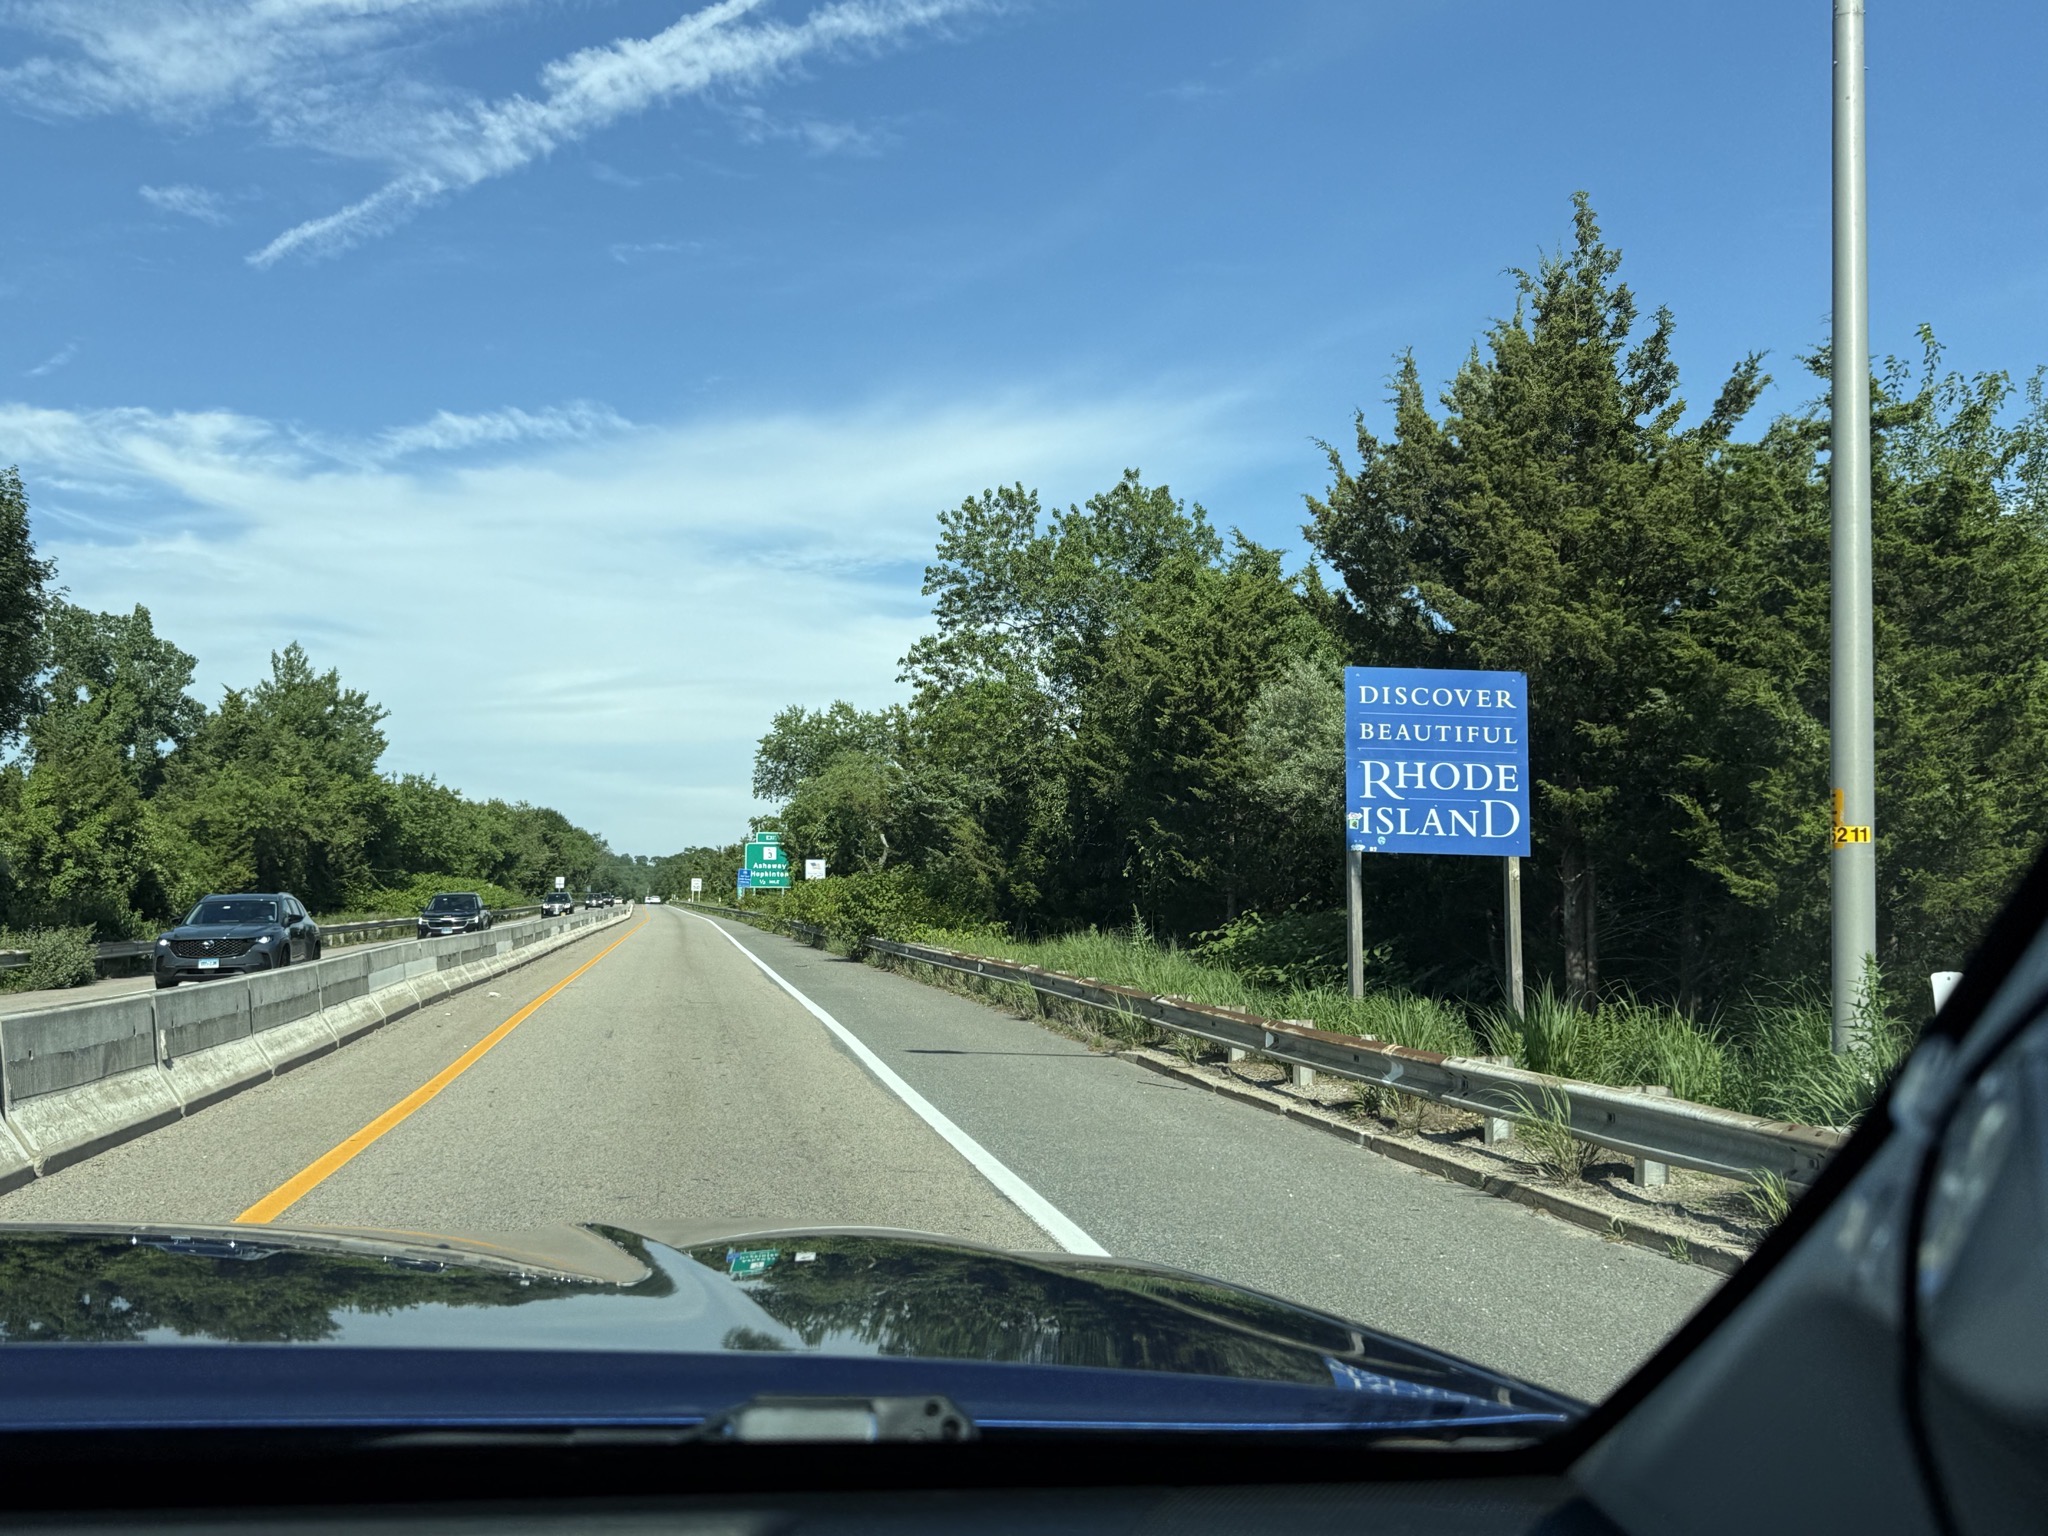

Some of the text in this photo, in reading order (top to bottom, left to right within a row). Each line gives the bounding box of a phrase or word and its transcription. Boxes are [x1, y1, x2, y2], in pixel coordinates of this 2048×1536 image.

[1358, 685, 1517, 709] DISCOVER
[1359, 722, 1518, 744] BEAUTIFUL
[1359, 760, 1519, 800] RHODE
[1360, 799, 1520, 838] ISLAND
[751, 870, 790, 878] Hopkinton
[753, 862, 787, 870] Ashaway
